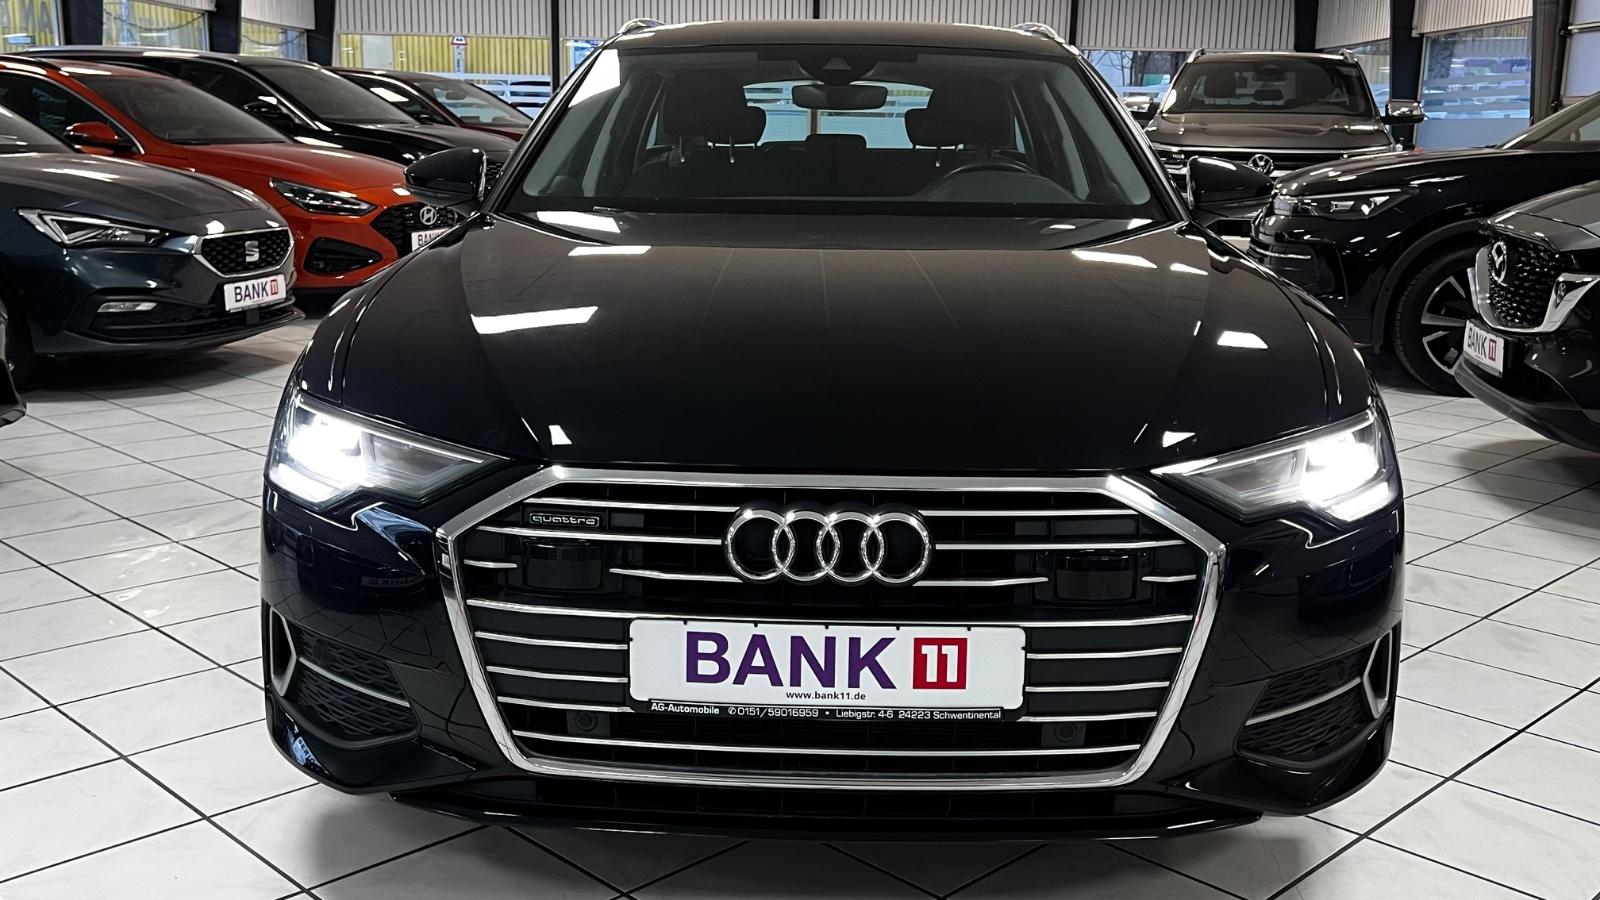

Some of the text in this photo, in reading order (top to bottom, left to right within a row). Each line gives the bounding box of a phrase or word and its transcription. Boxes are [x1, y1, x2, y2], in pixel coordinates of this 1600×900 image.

[234, 281, 269, 303] BANK
[1468, 327, 1487, 358] BANK
[532, 515, 596, 525] quattro
[686, 631, 961, 690] BANK 11
[785, 691, 867, 701] www.bank11.de
[650, 702, 1001, 720] AG-Automobile 0151/59016959 Liebigstr. 4-6 24223 Schwentinental
